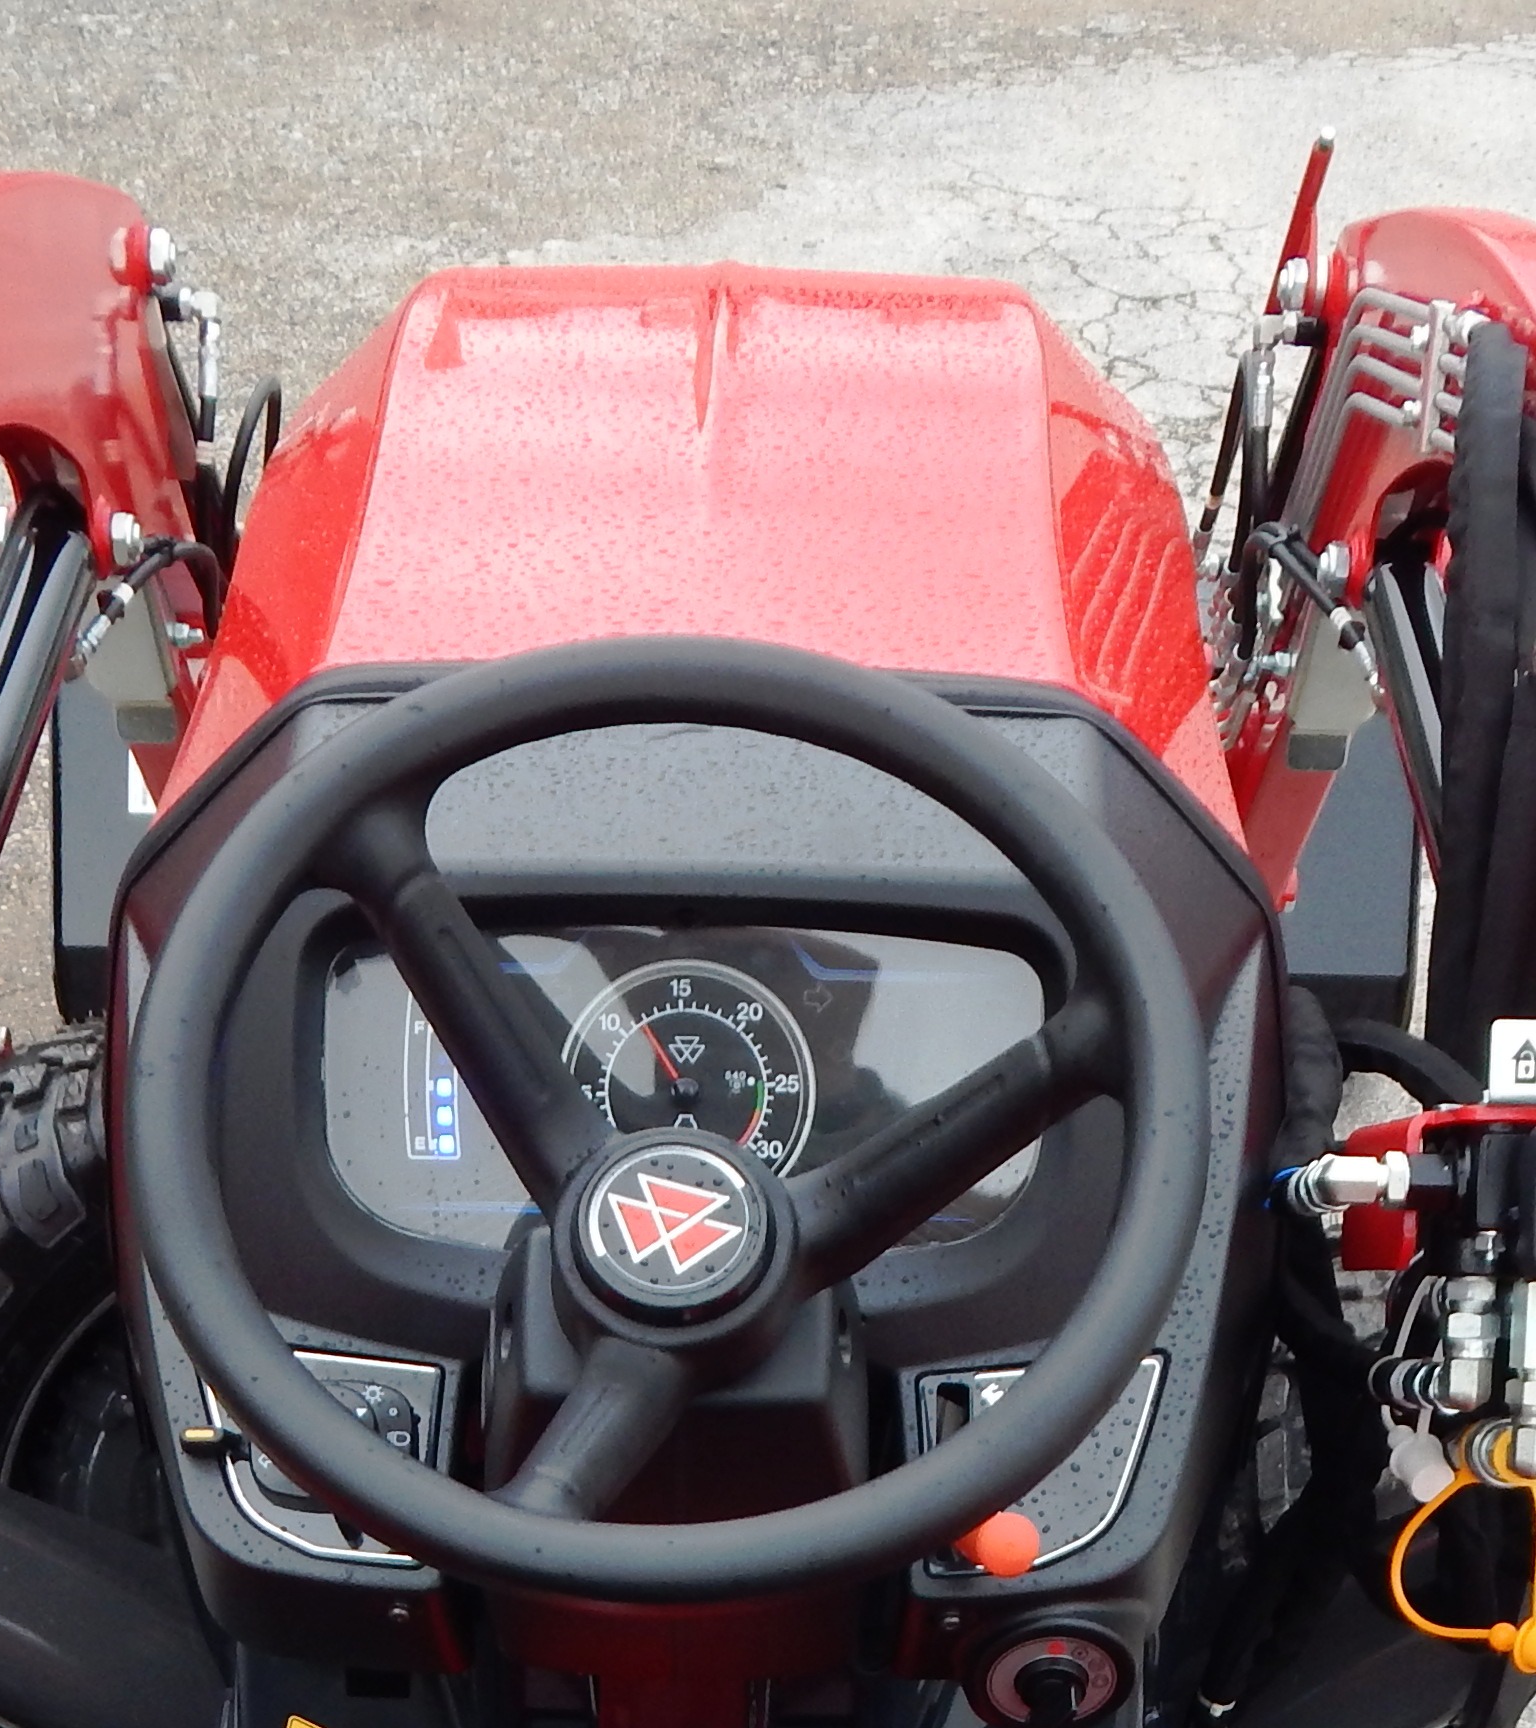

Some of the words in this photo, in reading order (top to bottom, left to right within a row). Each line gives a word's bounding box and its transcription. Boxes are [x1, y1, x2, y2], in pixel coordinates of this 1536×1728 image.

[669, 979, 692, 997] 15
[736, 1003, 763, 1021] 20
[414, 1020, 425, 1035] F
[599, 1013, 620, 1031] 10
[775, 1074, 799, 1093] 25
[414, 1136, 426, 1151] E
[756, 1141, 783, 1159] 30
